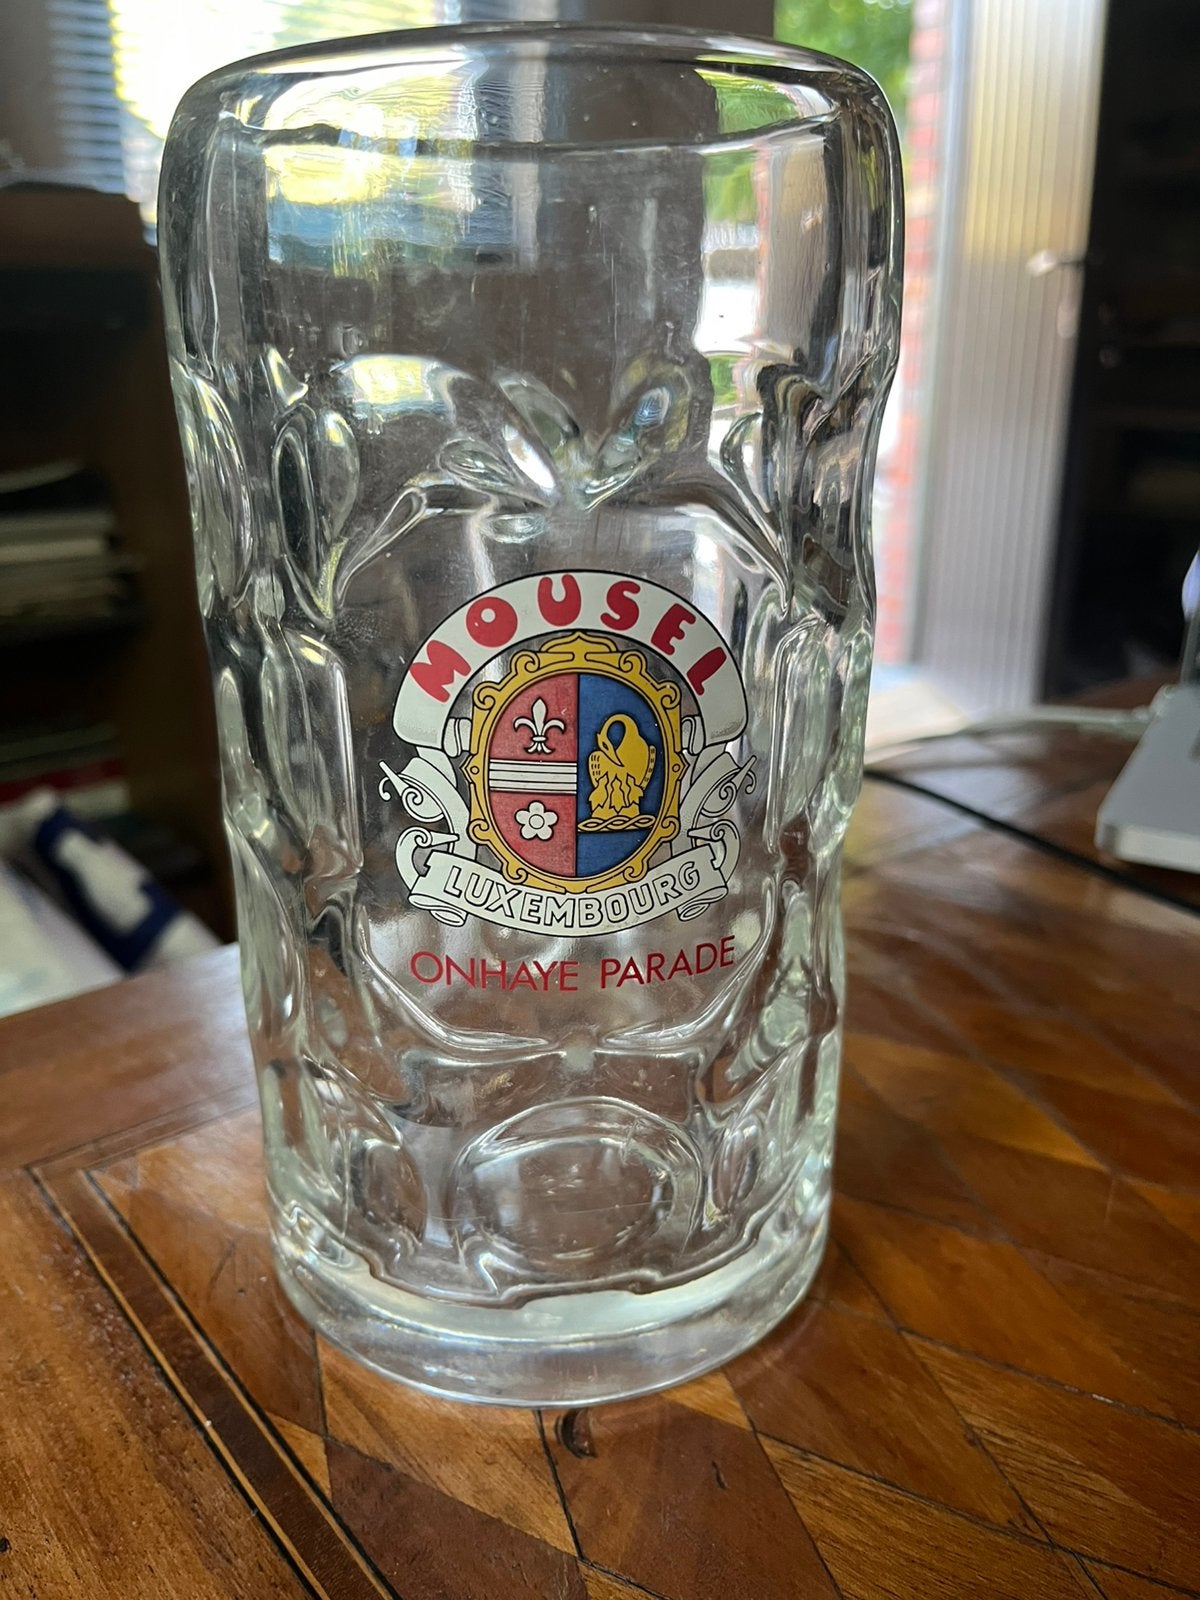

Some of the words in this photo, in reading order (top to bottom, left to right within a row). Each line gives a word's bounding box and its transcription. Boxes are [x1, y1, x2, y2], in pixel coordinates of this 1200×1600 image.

[408, 574, 728, 703] MOUSEL
[443, 860, 700, 928] LUXEMBOURG
[410, 950, 579, 991] ONHAYE
[600, 935, 736, 989] PARADE
